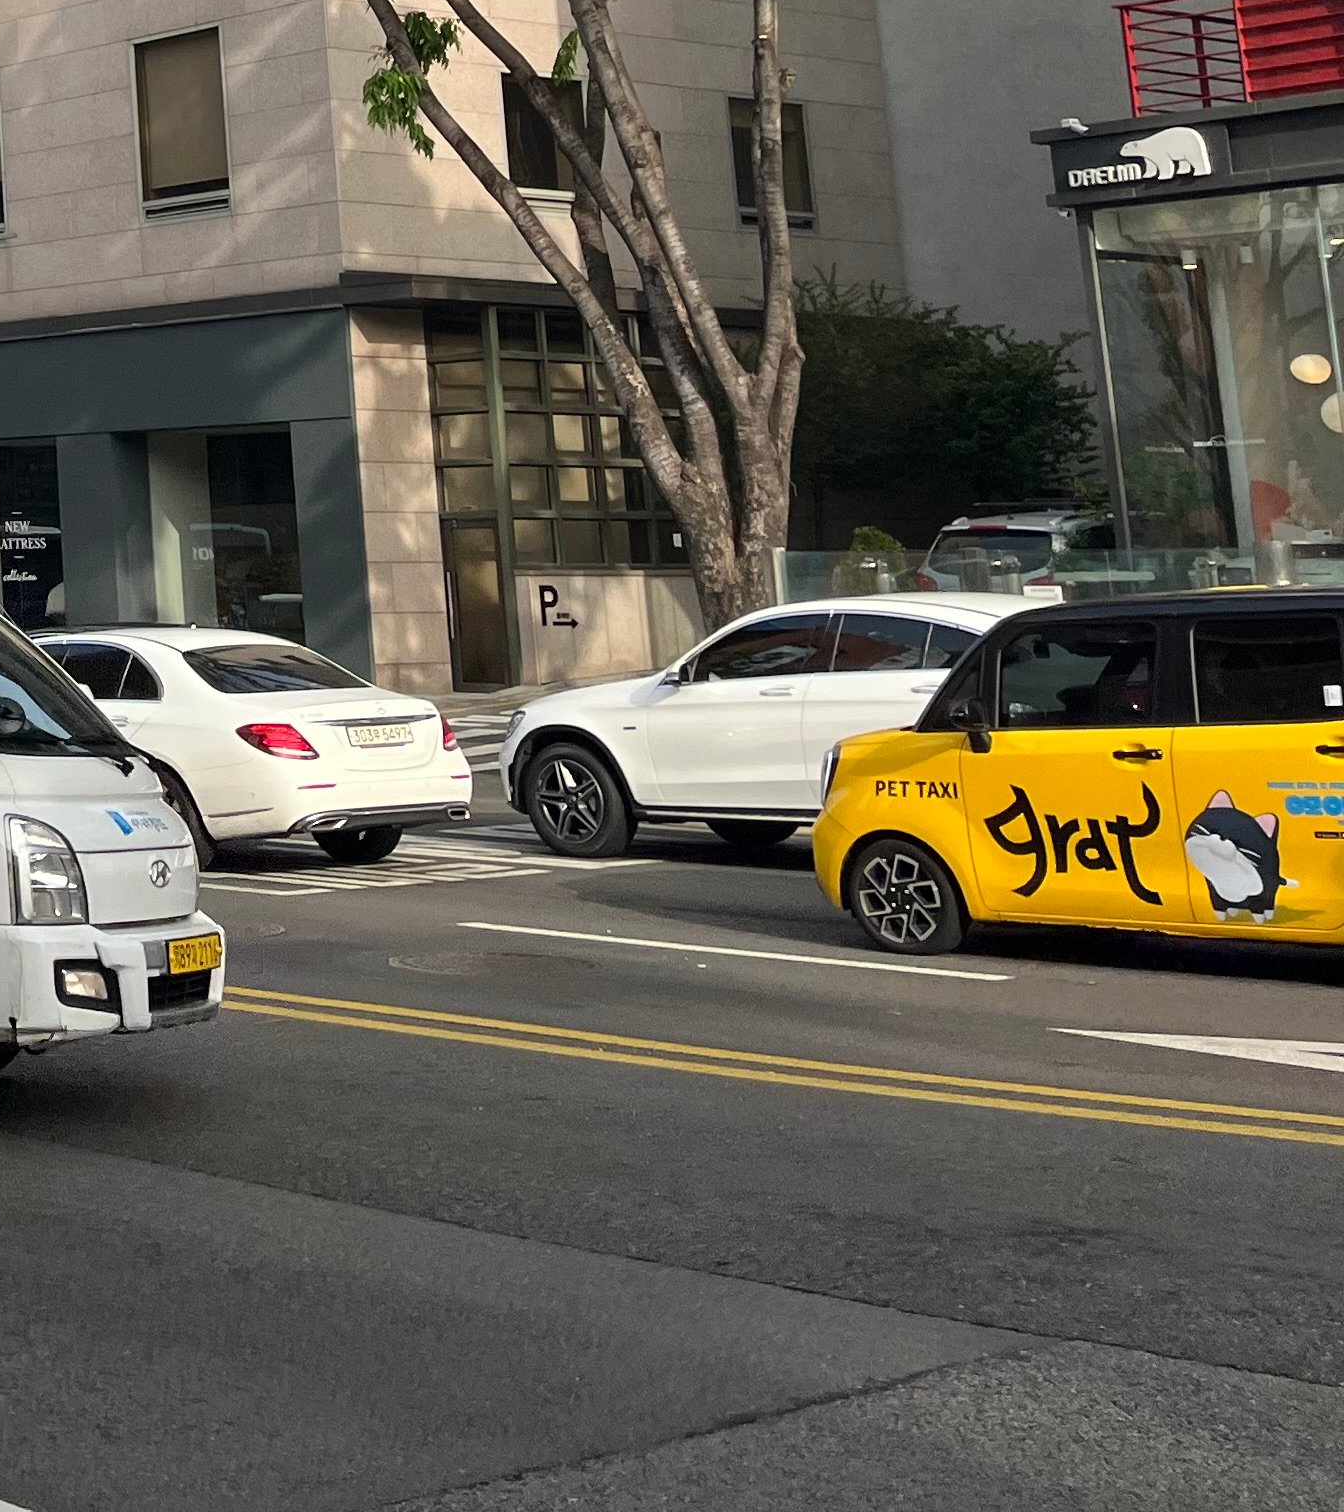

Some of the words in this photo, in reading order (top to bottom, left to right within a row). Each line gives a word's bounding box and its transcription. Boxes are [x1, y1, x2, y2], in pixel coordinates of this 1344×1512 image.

[4, 520, 31, 533] NEW
[539, 584, 559, 627] P
[875, 780, 909, 798] PET
[915, 781, 959, 800] TAXI
